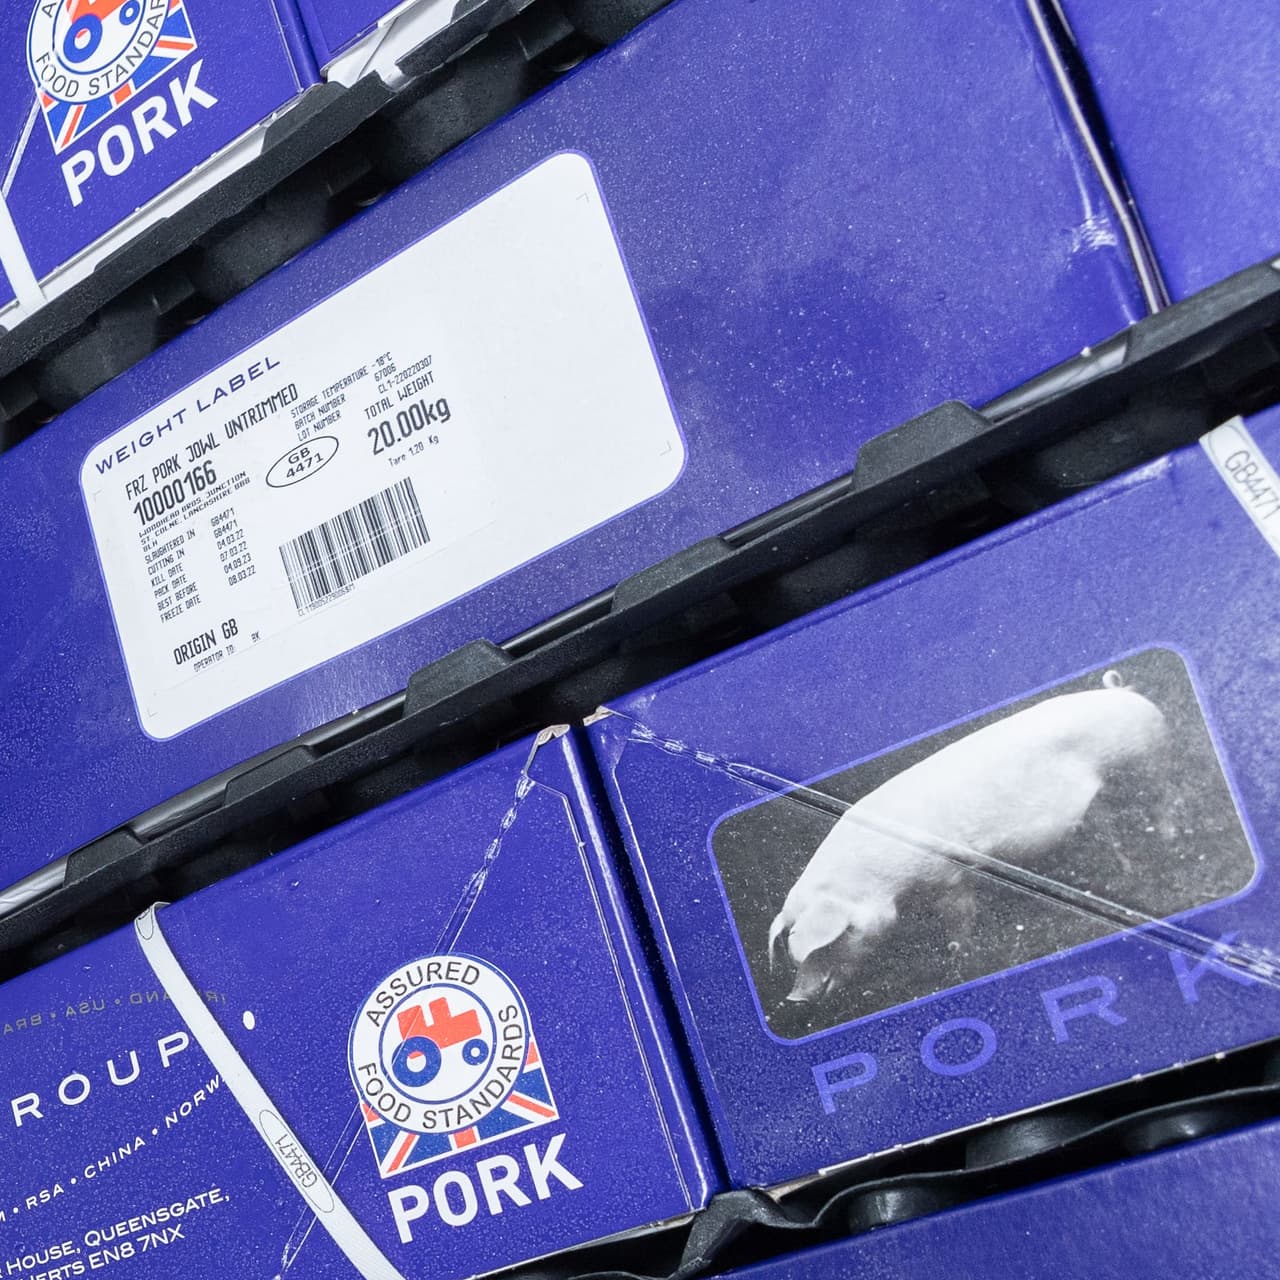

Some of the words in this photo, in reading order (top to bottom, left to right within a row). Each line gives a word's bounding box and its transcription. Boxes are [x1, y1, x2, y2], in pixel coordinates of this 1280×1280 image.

[36, 52, 80, 98] FOOD
[88, 0, 166, 96] STANDAR
[61, 59, 218, 207] PORK
[95, 408, 186, 474] WEIGHT
[196, 357, 279, 412] LABEL
[125, 473, 148, 500] FRZ
[151, 453, 181, 483] PORK
[185, 432, 220, 462] JOWL
[224, 383, 298, 439] UNTRIMMED
[367, 397, 451, 455] 20.00kg
[133, 459, 216, 525] 10000166
[366, 961, 480, 1027] ASSURED
[811, 931, 1255, 1114] PORK
[358, 1063, 412, 1123] FOOD
[423, 1005, 522, 1129] STANDARDS
[25, 1183, 64, 1209] RSA
[84, 1136, 145, 1178] CHINA
[165, 1074, 219, 1128] NORW
[278, 1136, 321, 1191] GB4471
[387, 1133, 584, 1244] PORK
[5, 1240, 80, 1275] HOUSE,
[84, 1188, 229, 1246] QUEENSGATE,
[88, 1241, 135, 1269] EN8
[136, 1223, 185, 1252] 7NX
